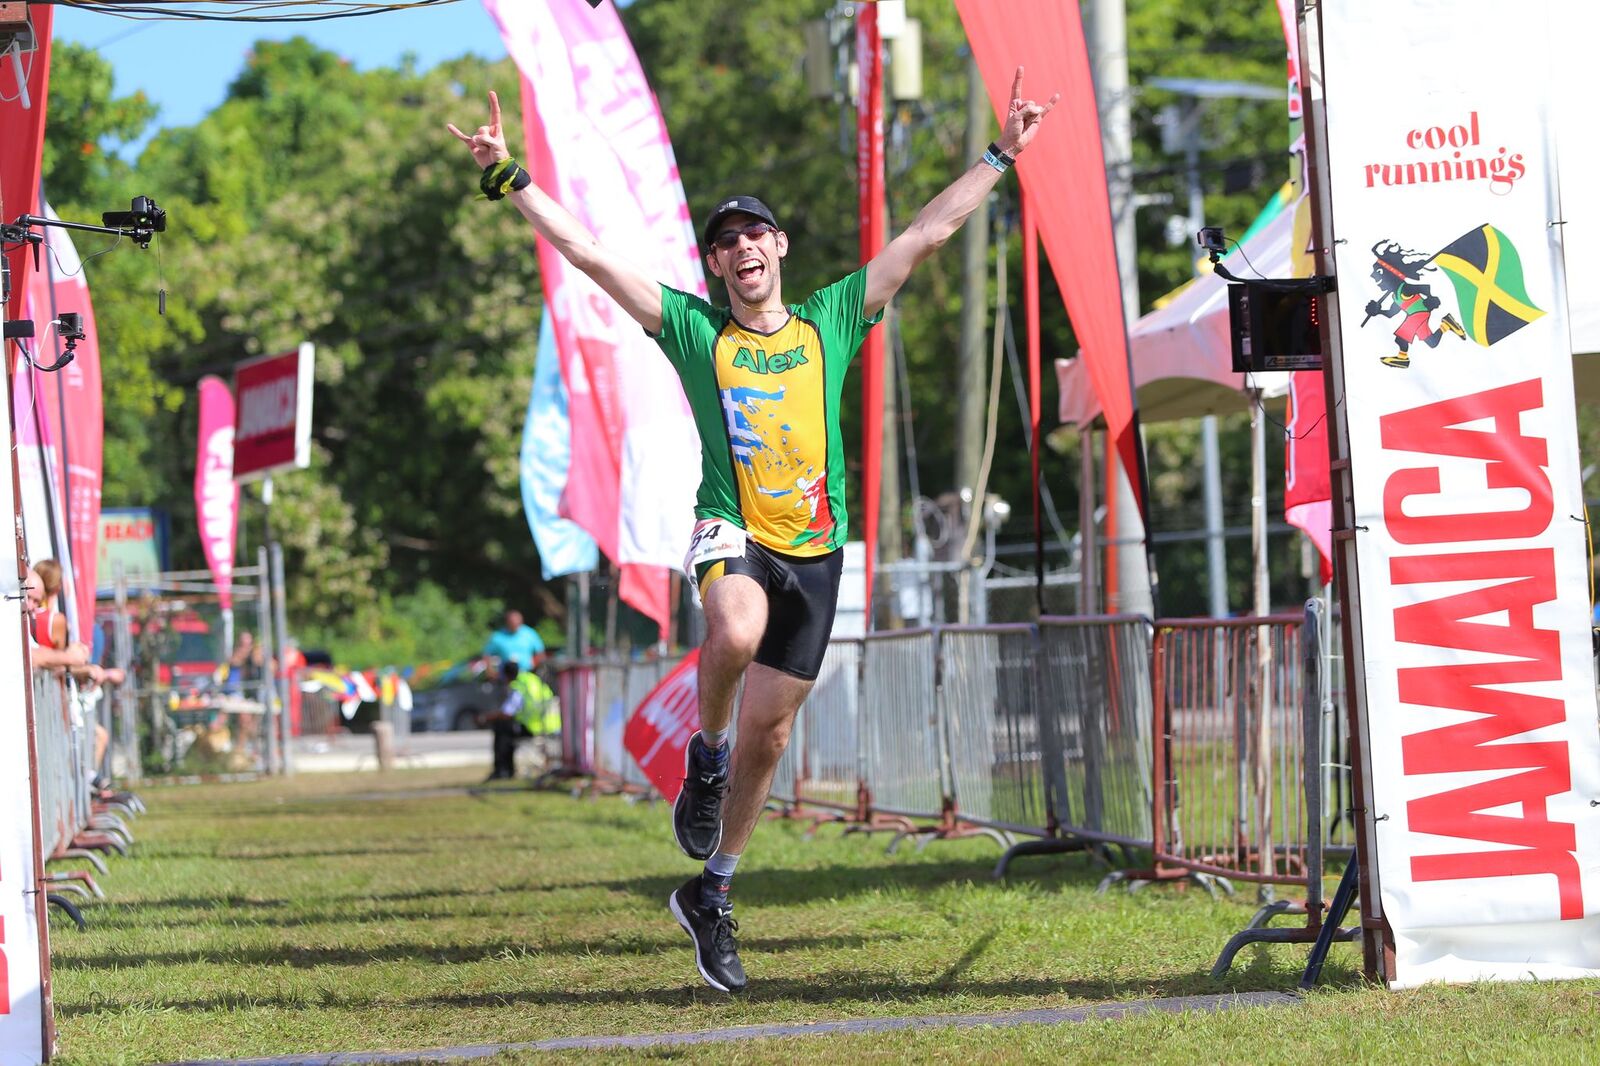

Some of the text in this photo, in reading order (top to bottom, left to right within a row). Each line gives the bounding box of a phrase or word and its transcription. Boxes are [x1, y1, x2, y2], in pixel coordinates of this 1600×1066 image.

[1406, 111, 1480, 149] cool
[1364, 147, 1526, 196] runnings
[732, 344, 808, 374] Alex
[1379, 378, 1584, 921] JAMAICA
